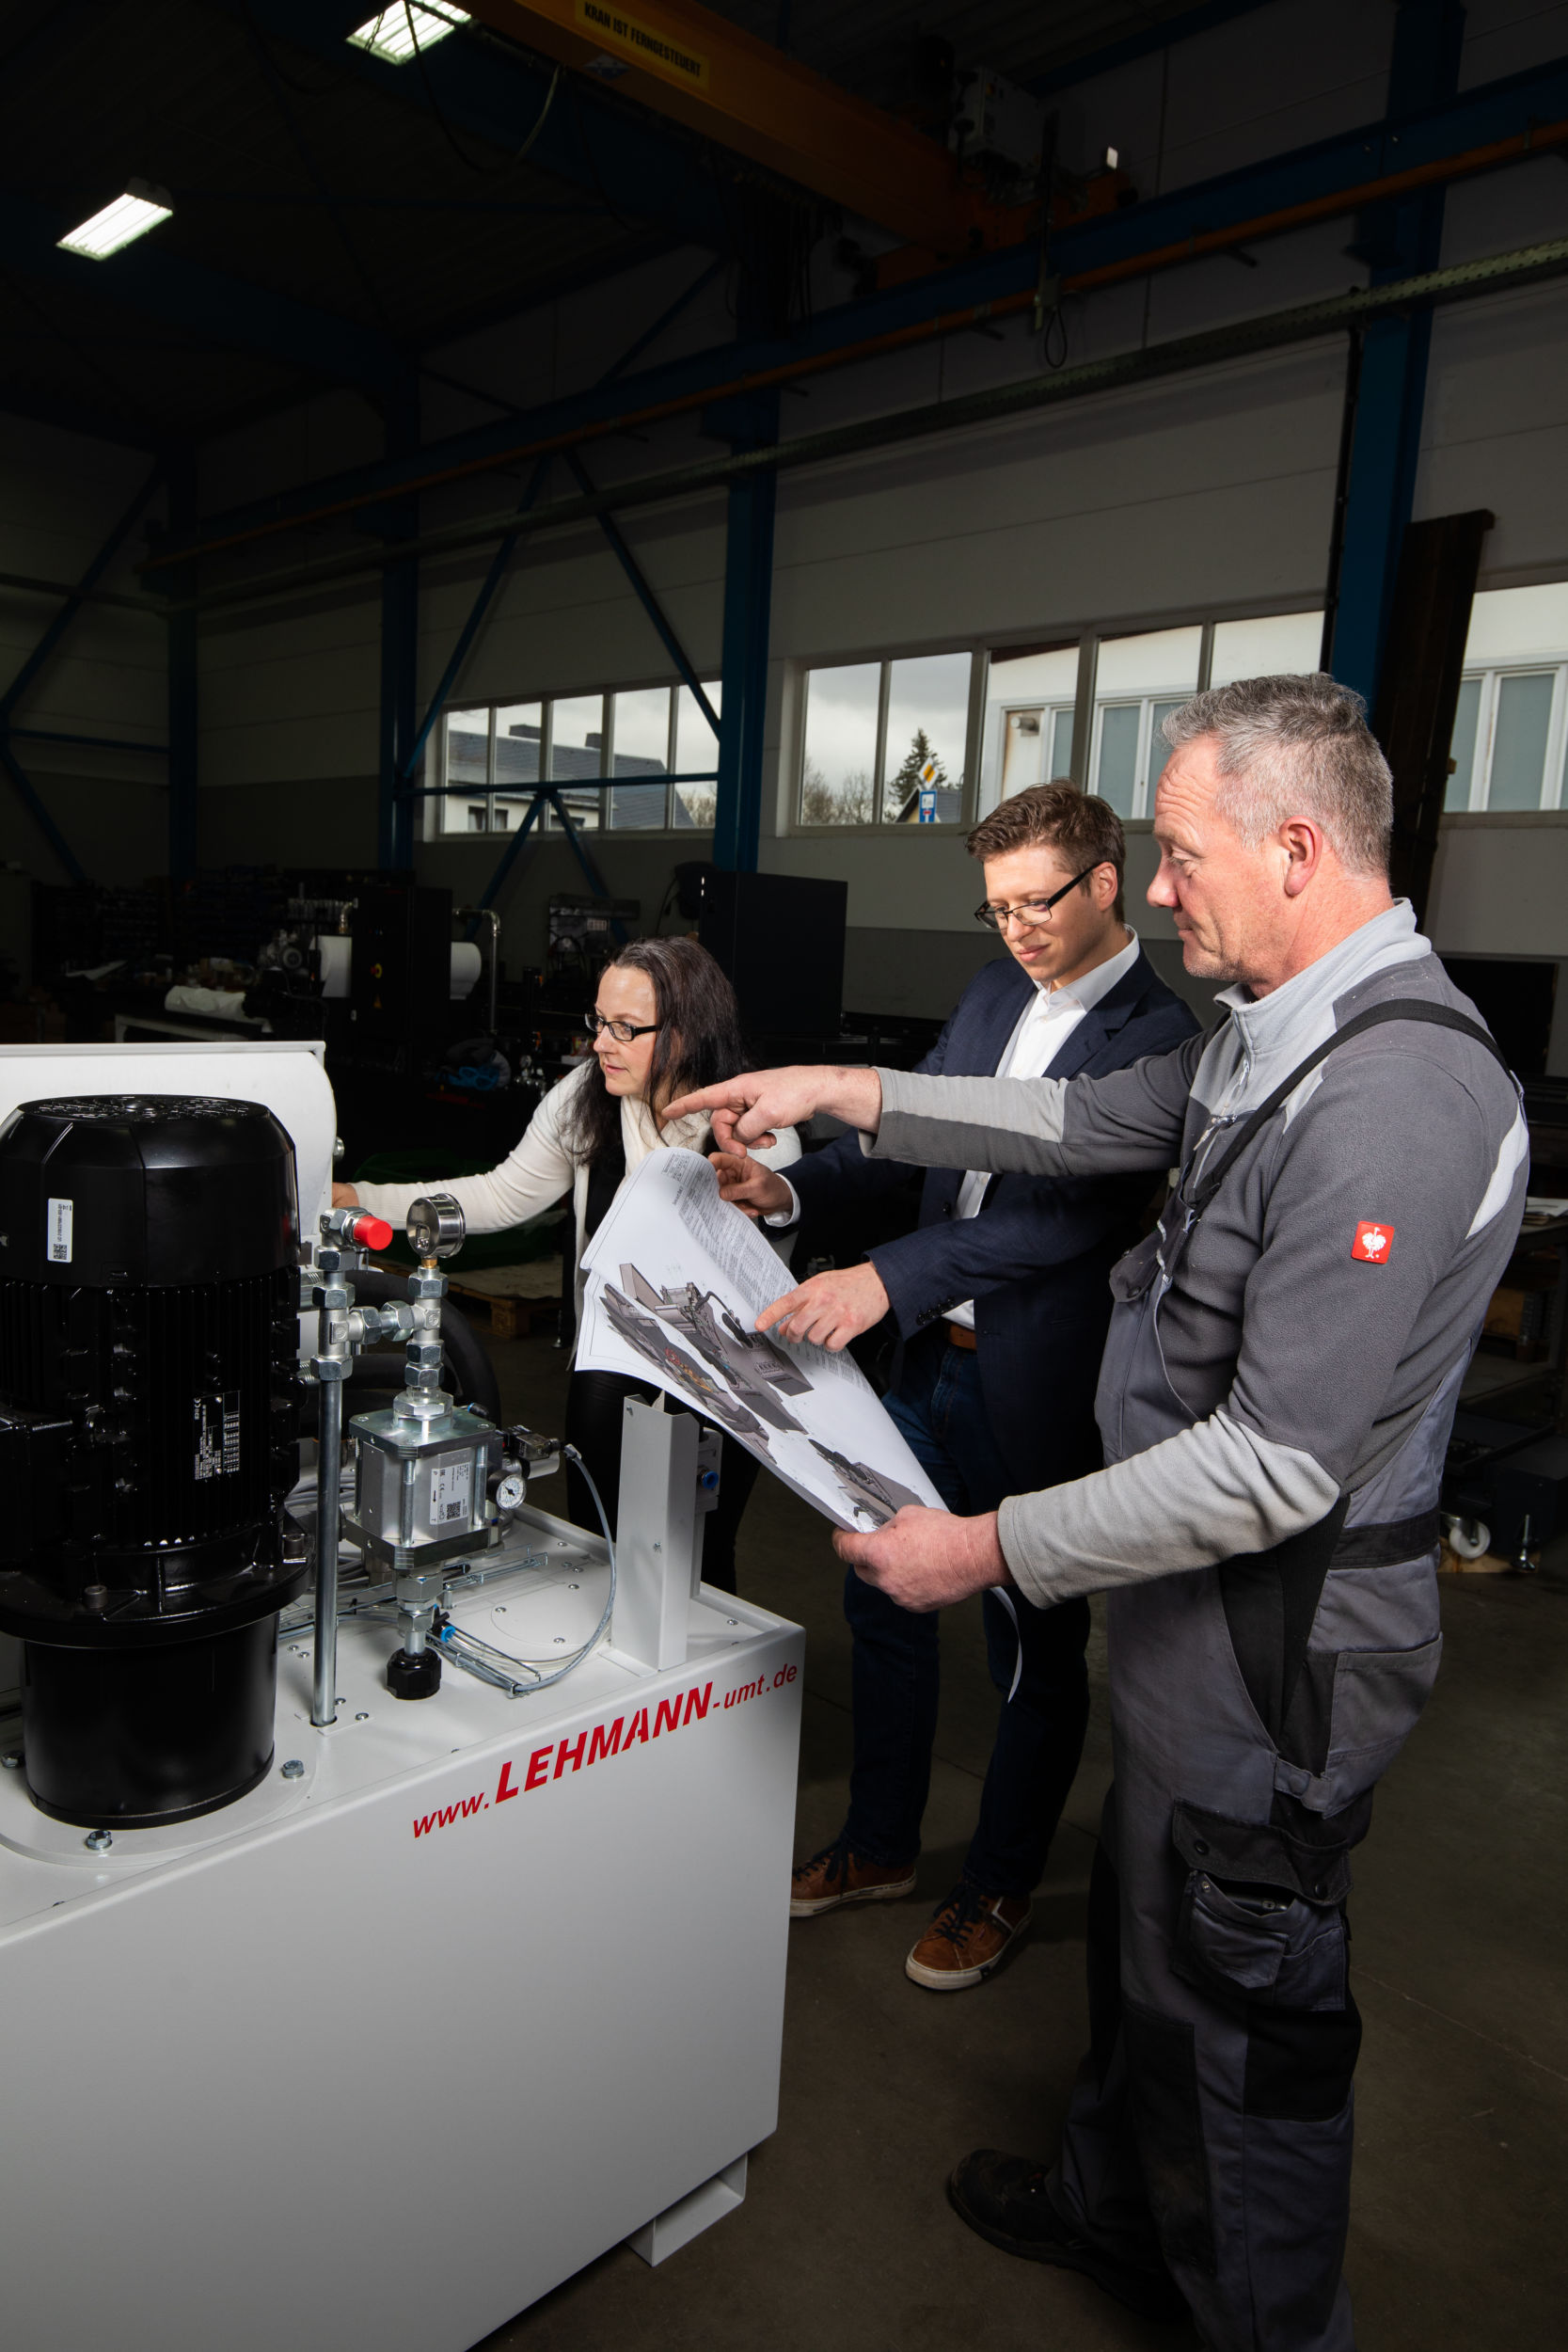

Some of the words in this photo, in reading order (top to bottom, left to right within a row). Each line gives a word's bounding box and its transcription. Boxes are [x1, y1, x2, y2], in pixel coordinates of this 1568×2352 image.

[584, 3, 610, 28] KRAN
[613, 18, 628, 39] IST
[630, 27, 701, 77] FERNGESTEUERT
